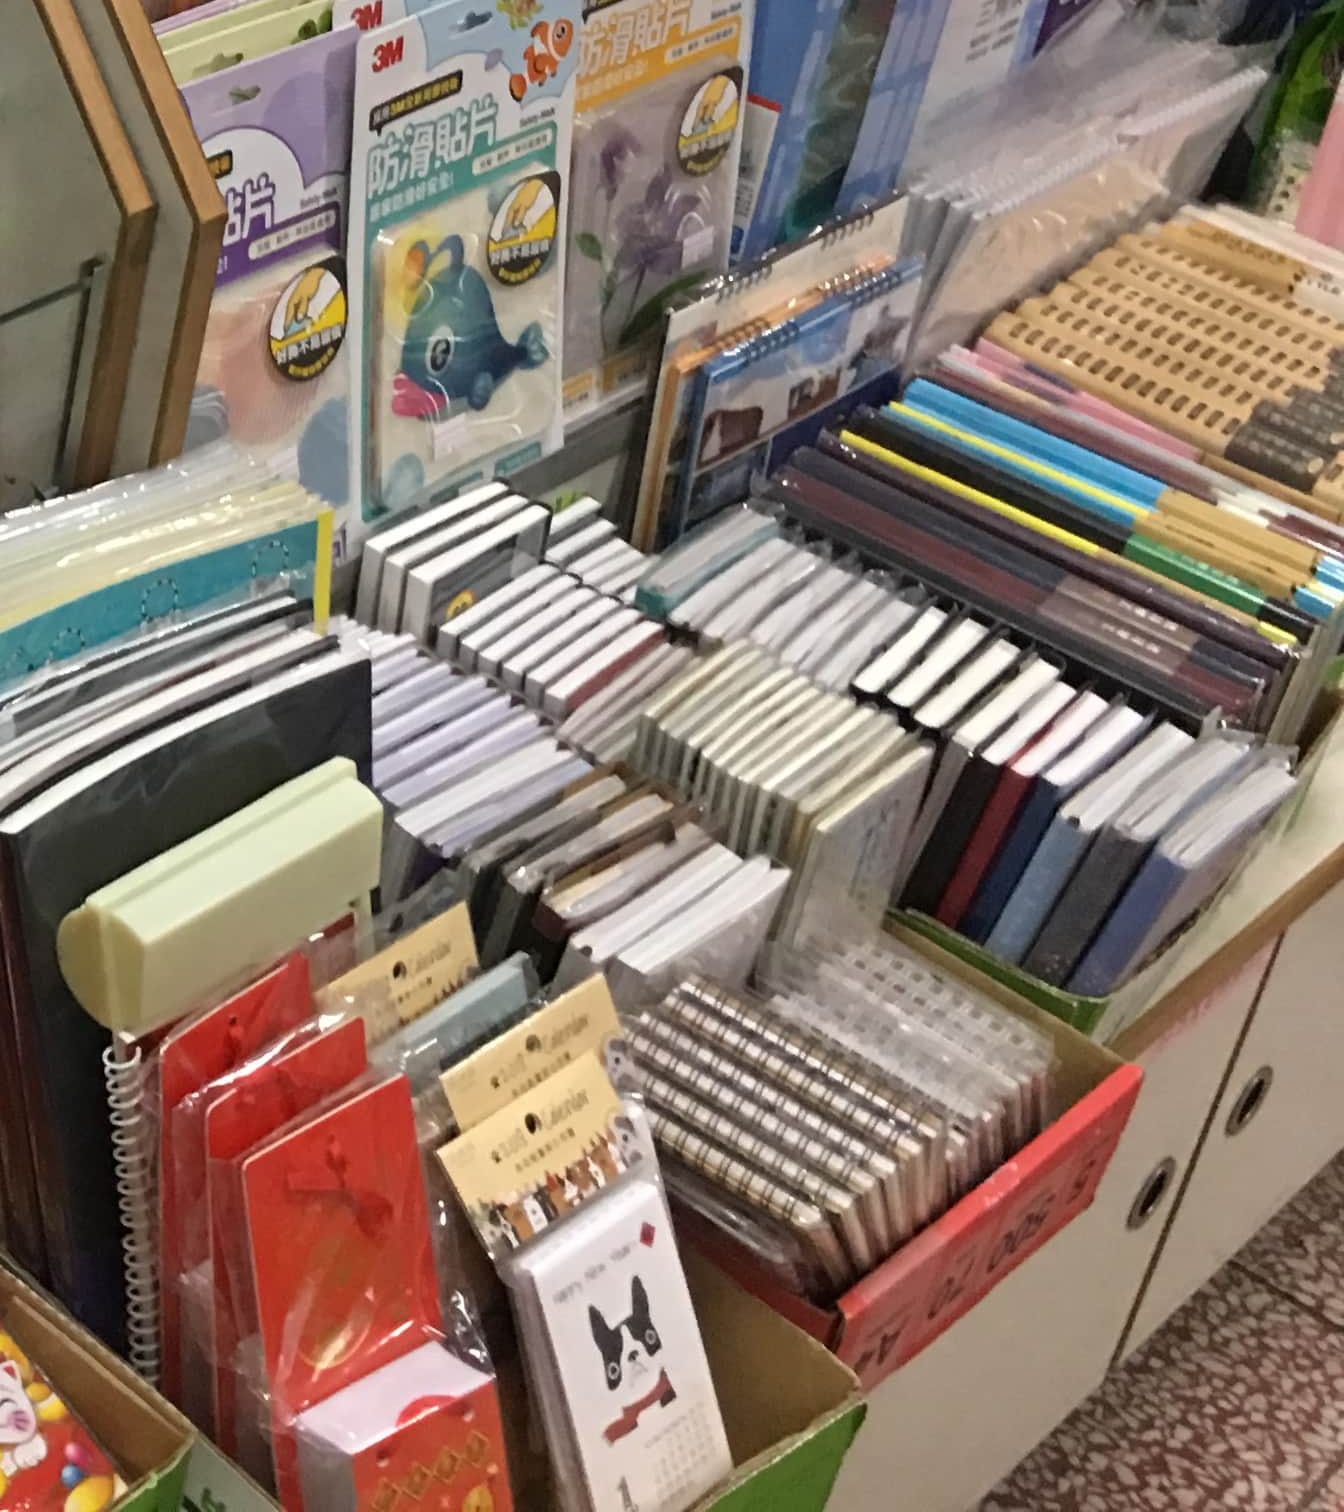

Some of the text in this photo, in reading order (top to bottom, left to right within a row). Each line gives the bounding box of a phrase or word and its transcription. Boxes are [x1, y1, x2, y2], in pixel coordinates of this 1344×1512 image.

[350, 0, 384, 30] 3M
[371, 35, 405, 74] 3M
[365, 91, 500, 200] 防滑貼片
